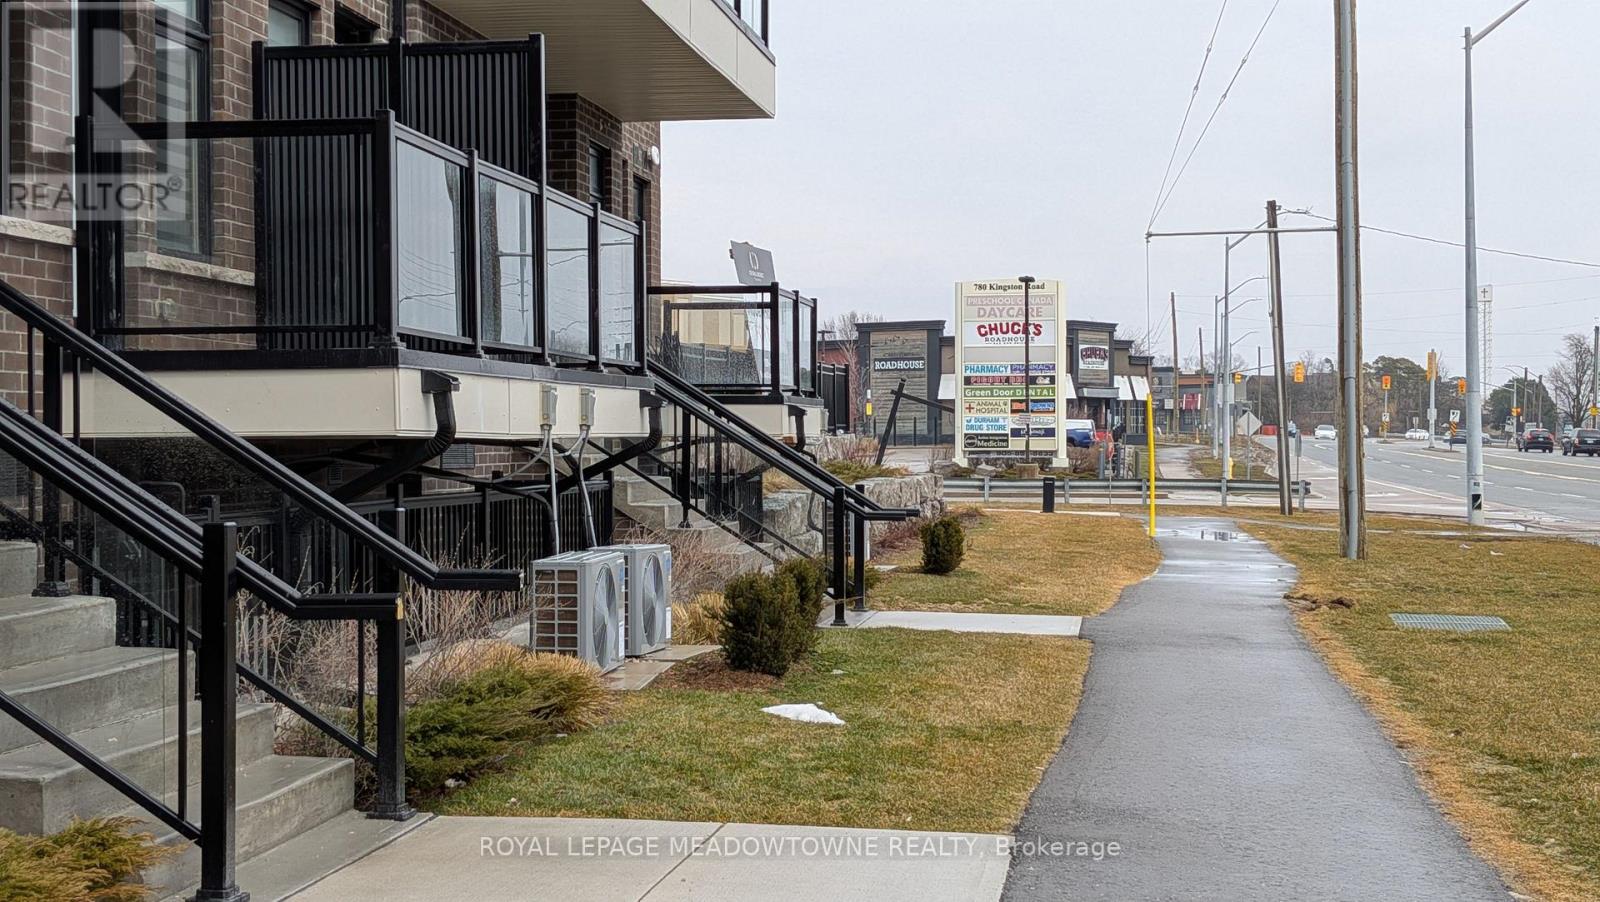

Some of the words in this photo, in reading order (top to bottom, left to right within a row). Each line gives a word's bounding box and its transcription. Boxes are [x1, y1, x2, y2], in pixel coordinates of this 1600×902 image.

[974, 283, 987, 291] 780
[989, 283, 1023, 292] Kingston
[968, 296, 1015, 306] PRESCHOOL
[1016, 296, 1053, 305] CNADA
[977, 306, 1043, 318] DAYCARE
[976, 322, 1043, 337] CHUCK'S
[874, 360, 925, 370] ROADHOUSE
[964, 364, 1009, 373] PHARMACY
[965, 389, 991, 397] Green
[993, 388, 1014, 396] Door
